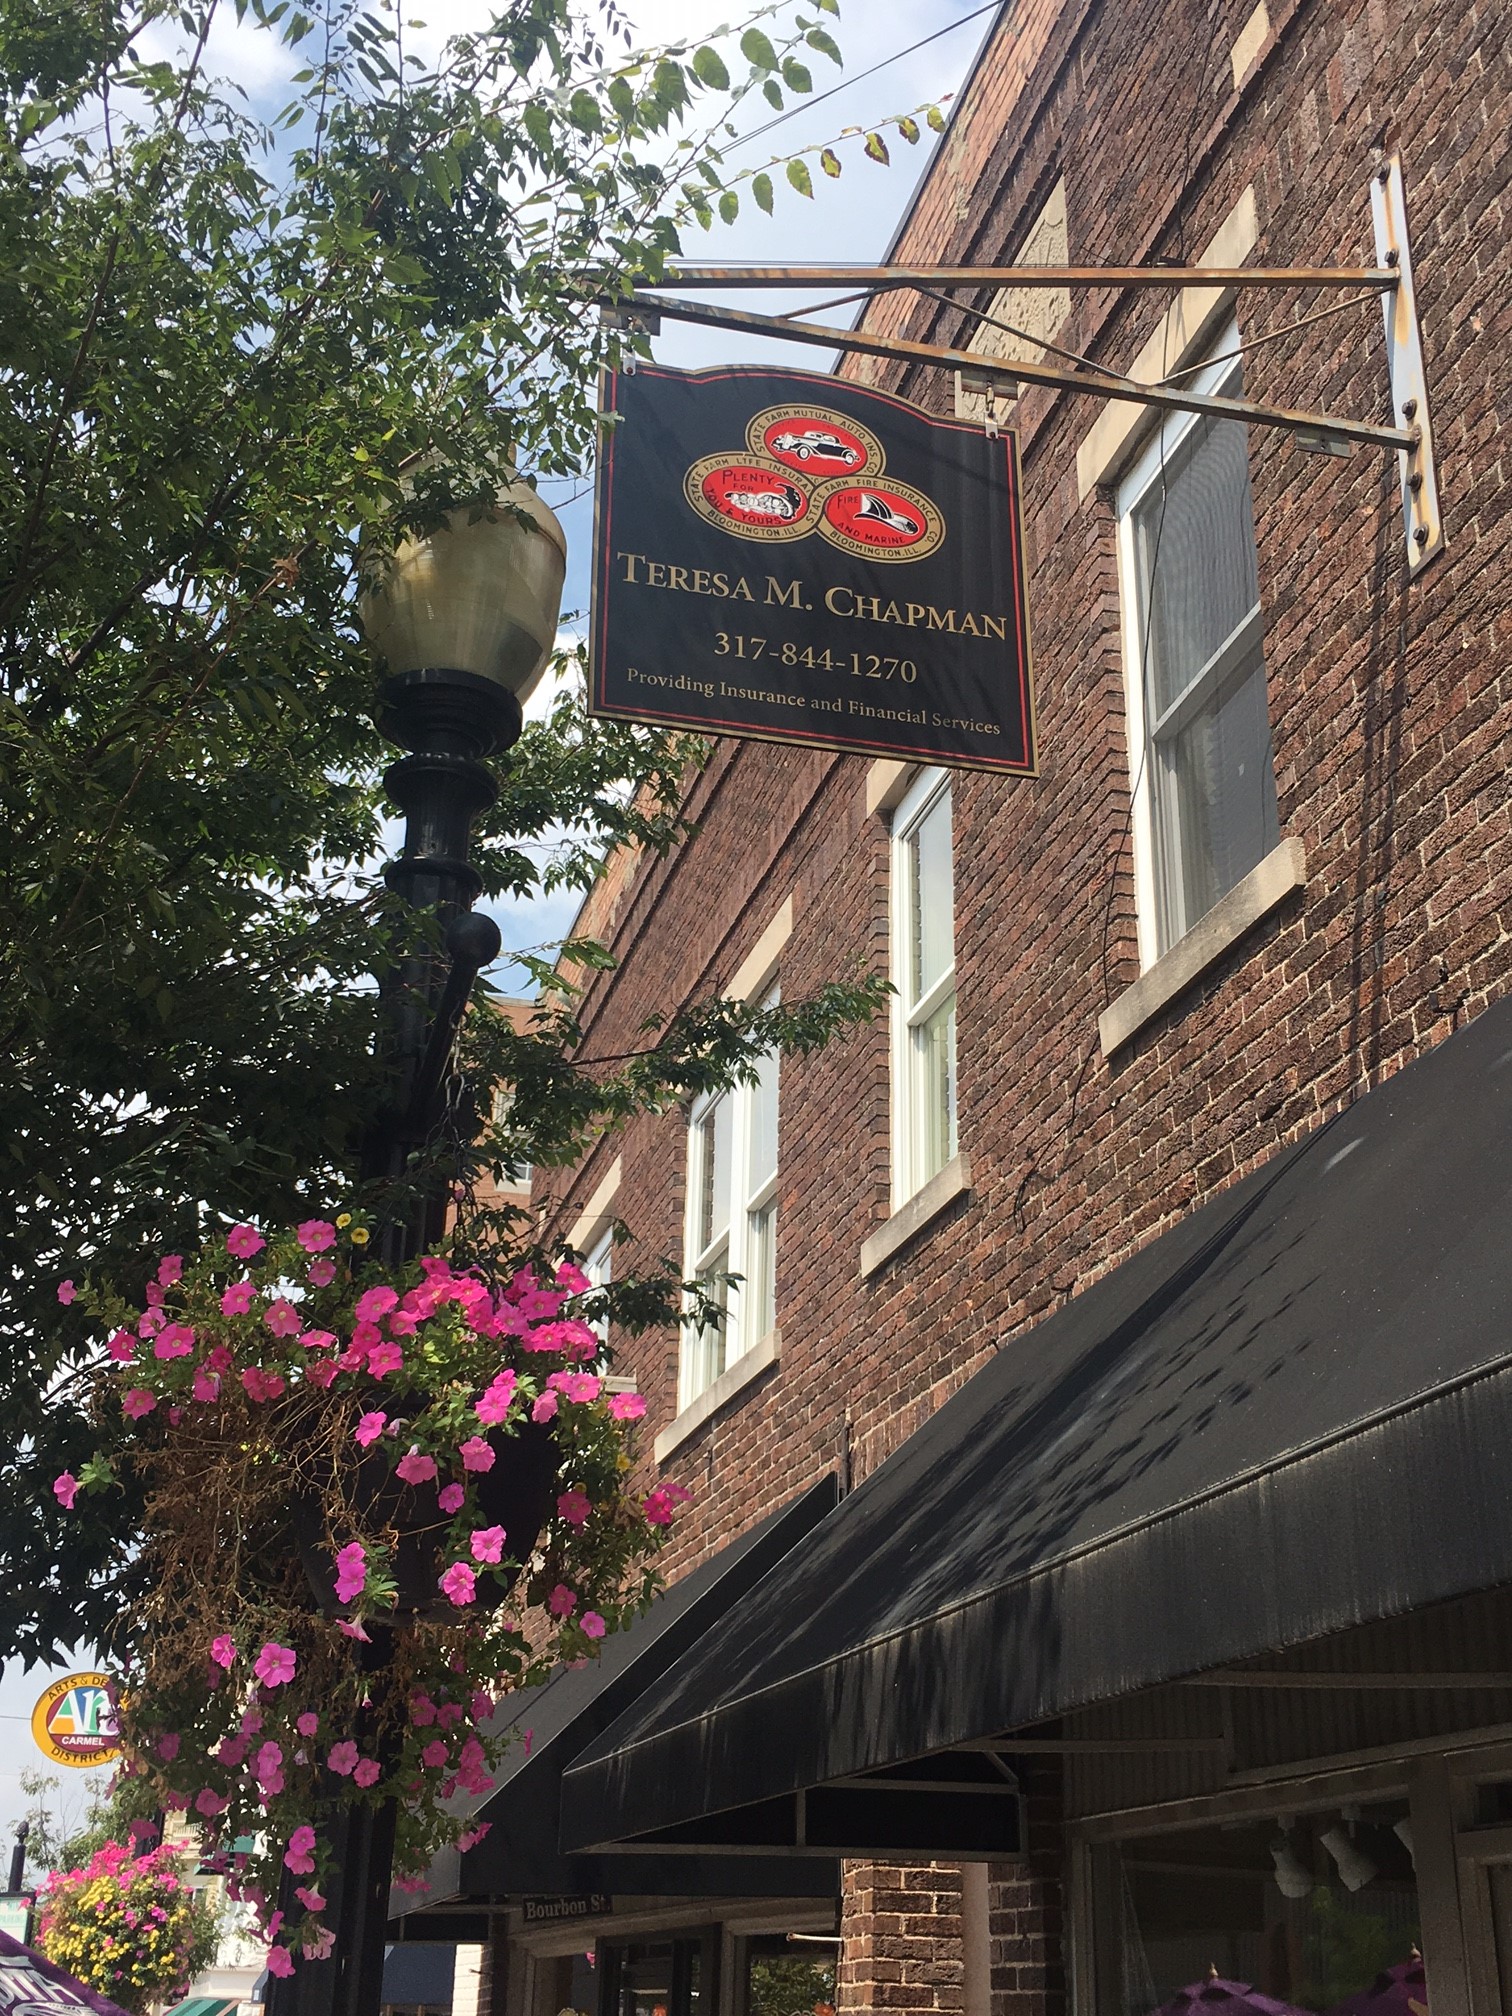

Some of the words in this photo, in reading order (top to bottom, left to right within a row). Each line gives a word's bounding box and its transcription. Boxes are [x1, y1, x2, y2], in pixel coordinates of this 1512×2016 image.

[752, 422, 766, 453] STATE
[765, 410, 790, 423] FARM
[793, 409, 834, 423] MUTUAL
[840, 420, 866, 440] AUTO
[865, 441, 878, 460] INS.
[691, 471, 704, 502] STATE
[703, 458, 729, 472] FARM
[736, 457, 761, 467] LIFE
[722, 469, 775, 485] PLENTY
[733, 483, 754, 492] FOR
[705, 487, 723, 509] YOU
[741, 514, 782, 525] YOURS
[806, 493, 825, 524] STATE
[824, 480, 850, 493] FARM
[857, 478, 878, 487] FIRE
[883, 482, 937, 523] INSURANCE
[837, 494, 859, 509] FIRE
[838, 522, 860, 537] AND
[864, 534, 905, 544] MARINE
[617, 551, 756, 602] TERESA
[763, 576, 813, 611] M.
[824, 586, 1007, 640] CHAPMAN
[714, 632, 917, 683] 317-844-1270
[627, 667, 715, 698] Providing
[720, 681, 806, 707] Insurance
[811, 698, 842, 713] and
[848, 700, 926, 725] Financial
[932, 712, 1000, 735] Services
[48, 1678, 77, 1701] ARTS
[80, 1676, 88, 1686] &
[61, 1735, 105, 1746] CARMEL
[51, 1746, 109, 1763] DISTRICT
[525, 1898, 588, 1919] Bourbon
